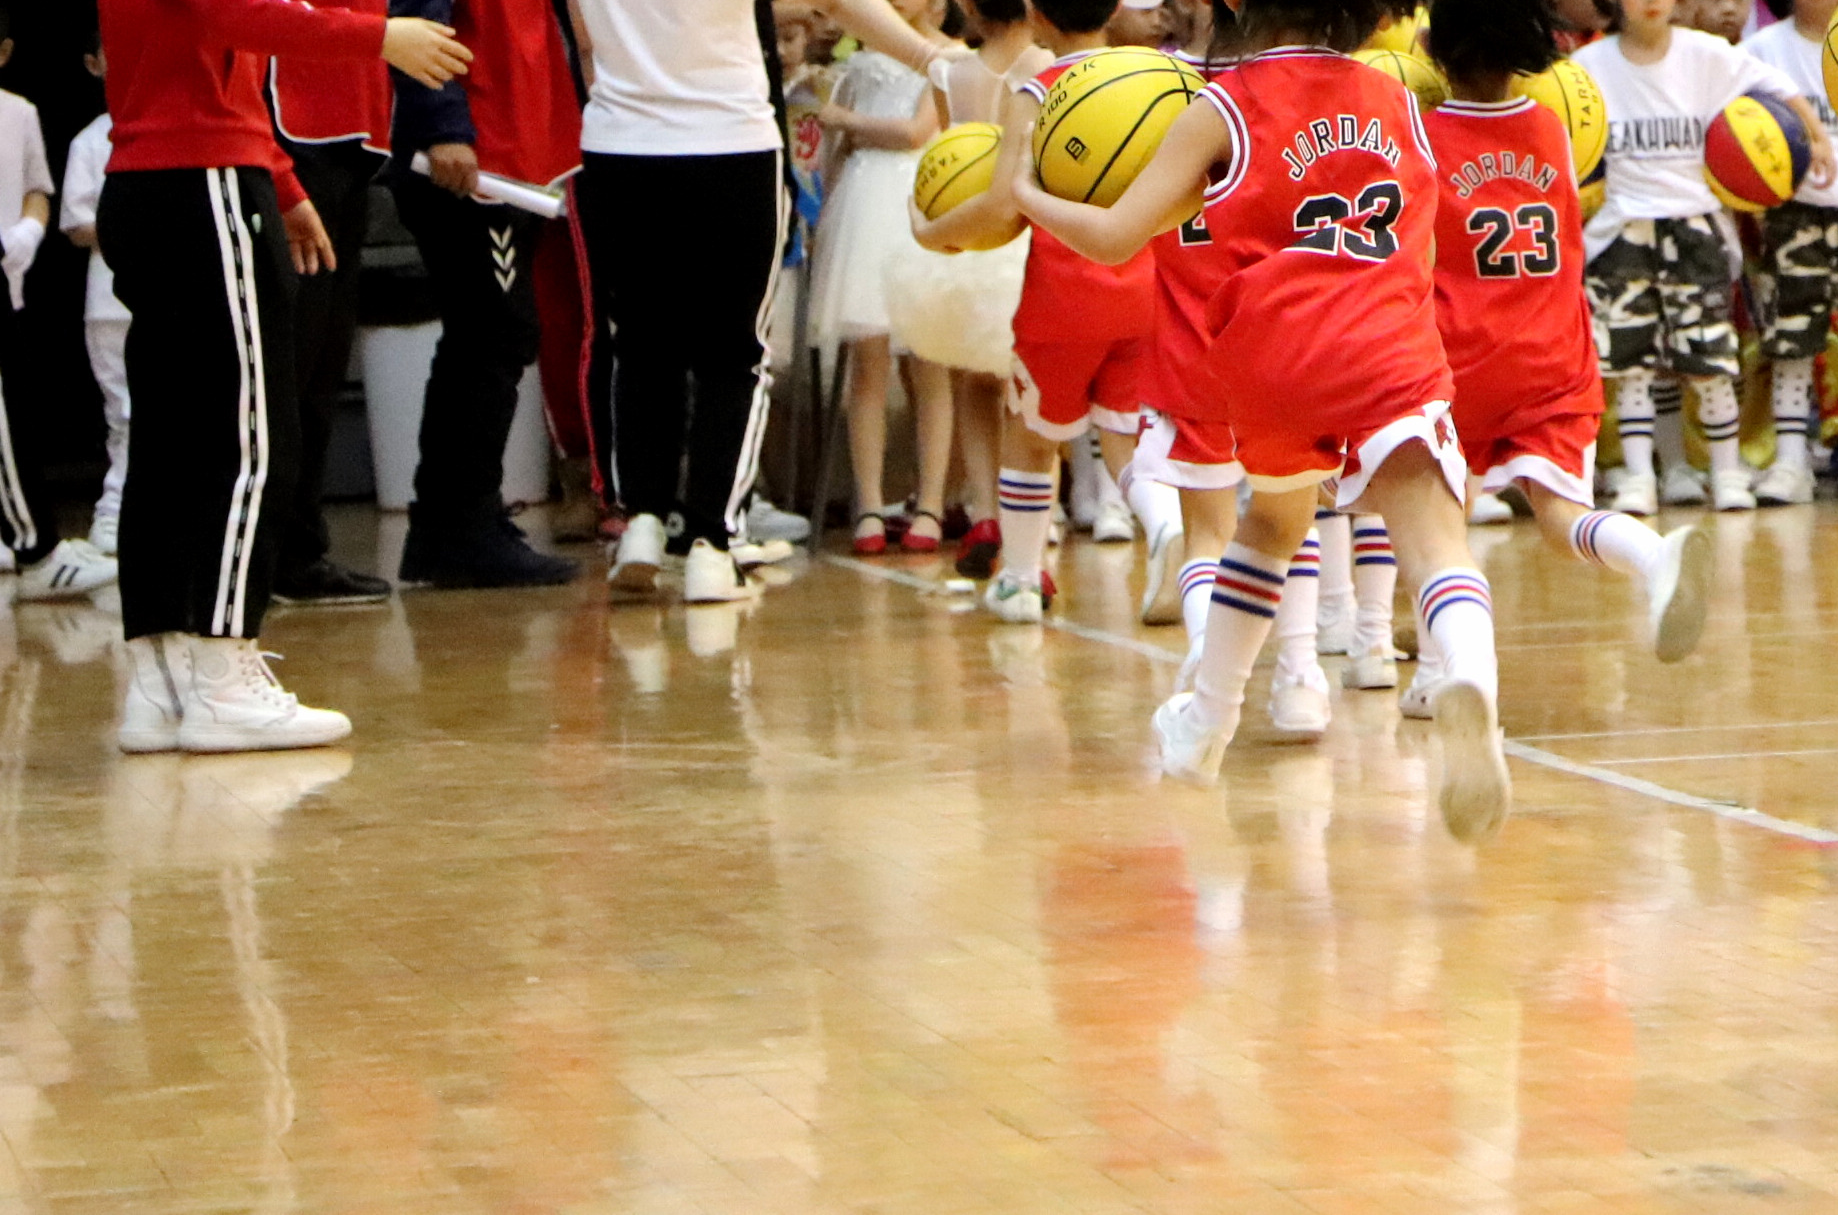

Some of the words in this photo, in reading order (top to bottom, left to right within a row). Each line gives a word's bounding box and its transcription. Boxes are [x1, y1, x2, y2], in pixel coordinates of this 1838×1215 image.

[1282, 114, 1402, 181] JORDAN
[1450, 151, 1558, 198] JORDAN
[1282, 180, 1405, 262] 23
[1466, 202, 1561, 279] 23
